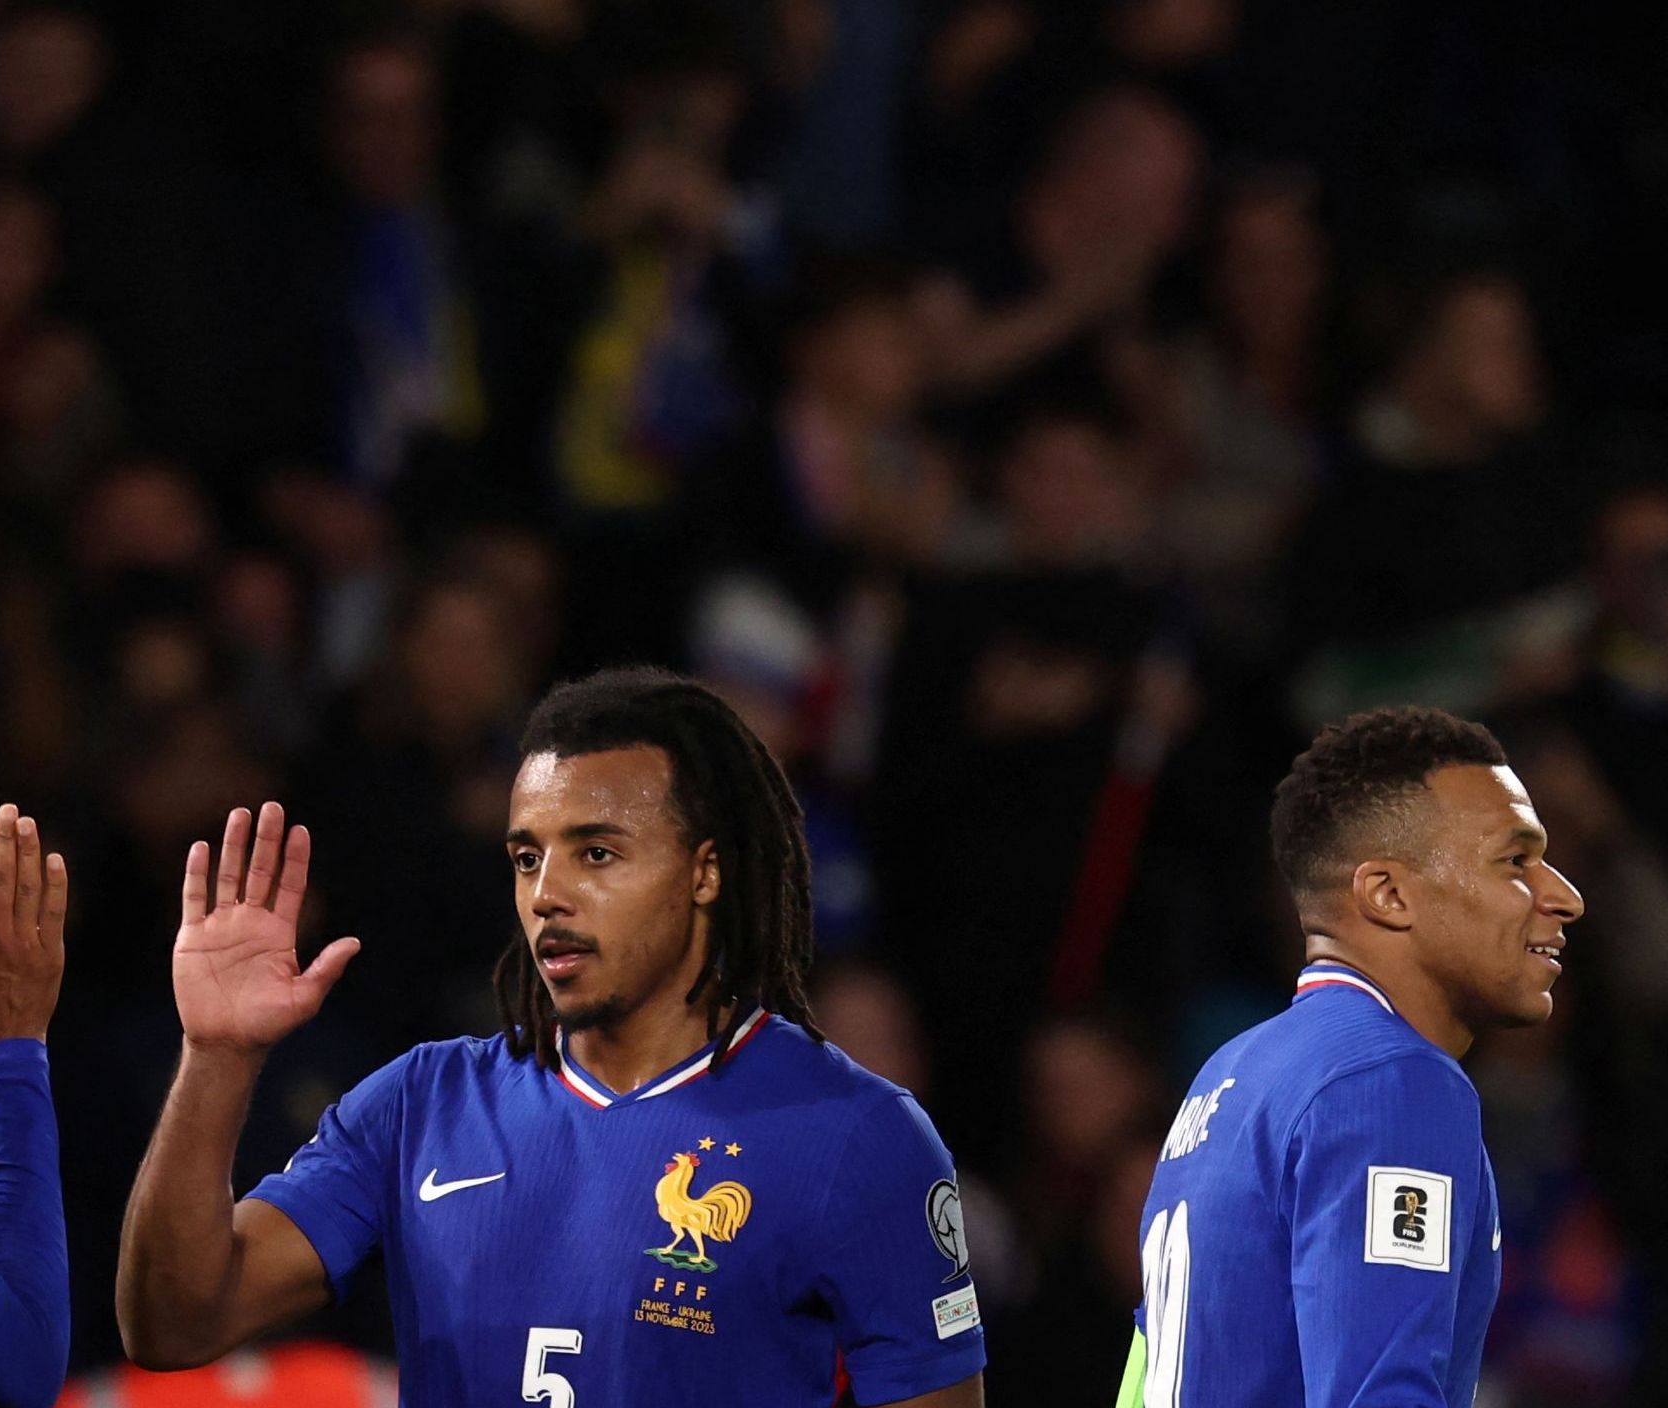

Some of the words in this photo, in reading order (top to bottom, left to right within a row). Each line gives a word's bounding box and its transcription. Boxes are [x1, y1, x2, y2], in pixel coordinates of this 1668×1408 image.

[641, 1299, 670, 1314] FRANCE
[678, 1305, 712, 1322] UKRAINE
[646, 1311, 689, 1329] NOVEMBRE
[690, 1319, 716, 1335] 2025
